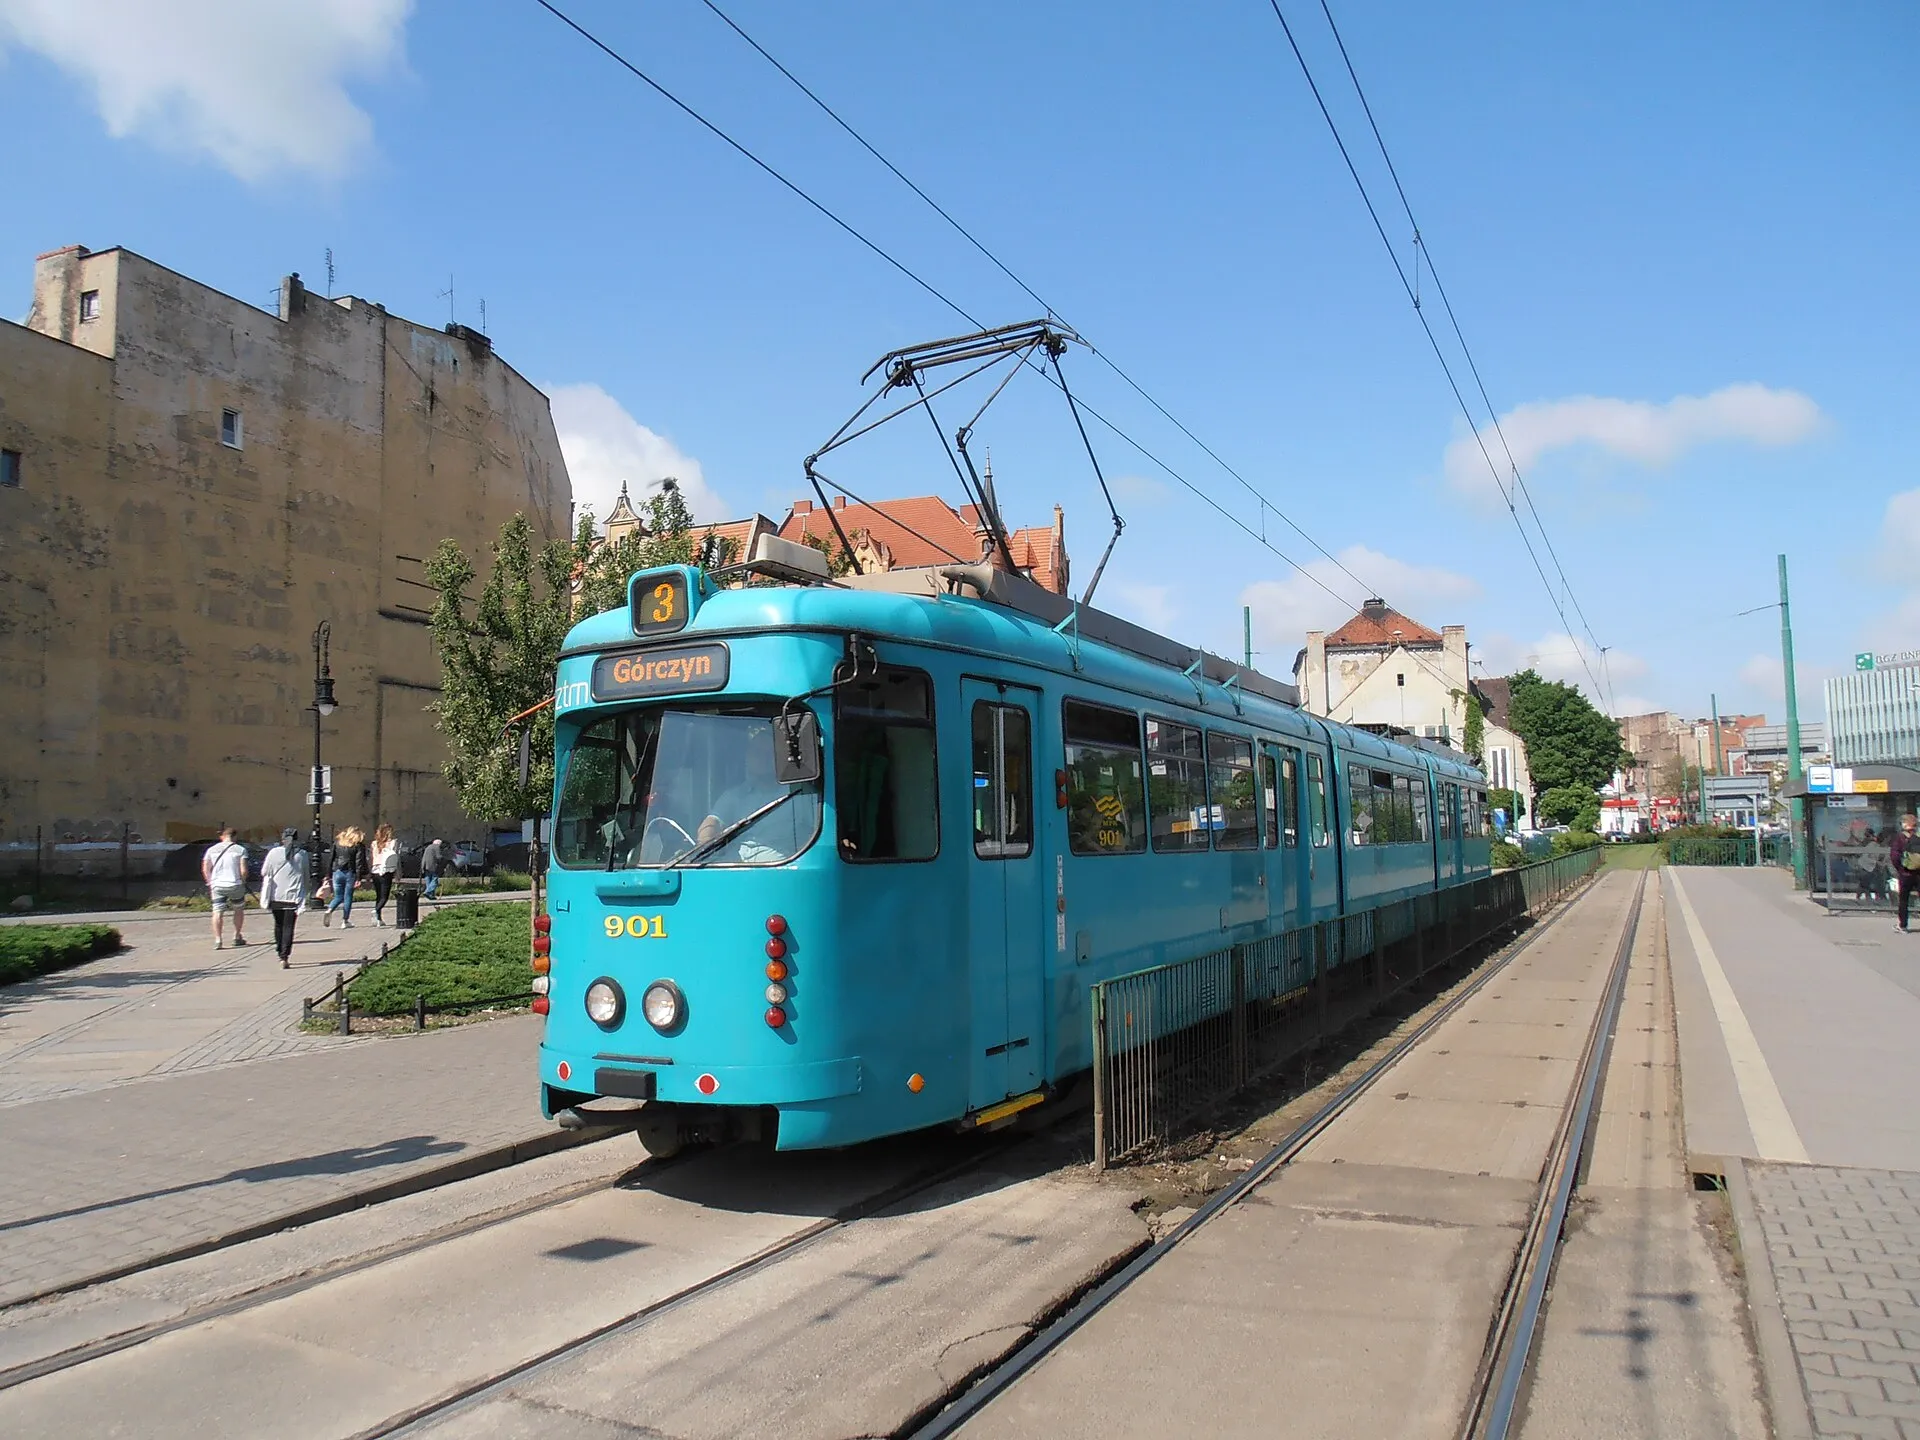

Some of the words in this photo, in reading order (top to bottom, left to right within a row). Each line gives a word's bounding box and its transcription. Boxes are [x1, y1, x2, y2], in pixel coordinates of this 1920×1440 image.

[652, 583, 675, 623] 3
[613, 656, 711, 683] Górczyn
[555, 679, 588, 710] ztm
[1099, 829, 1122, 846] 901
[604, 914, 668, 939] 901
